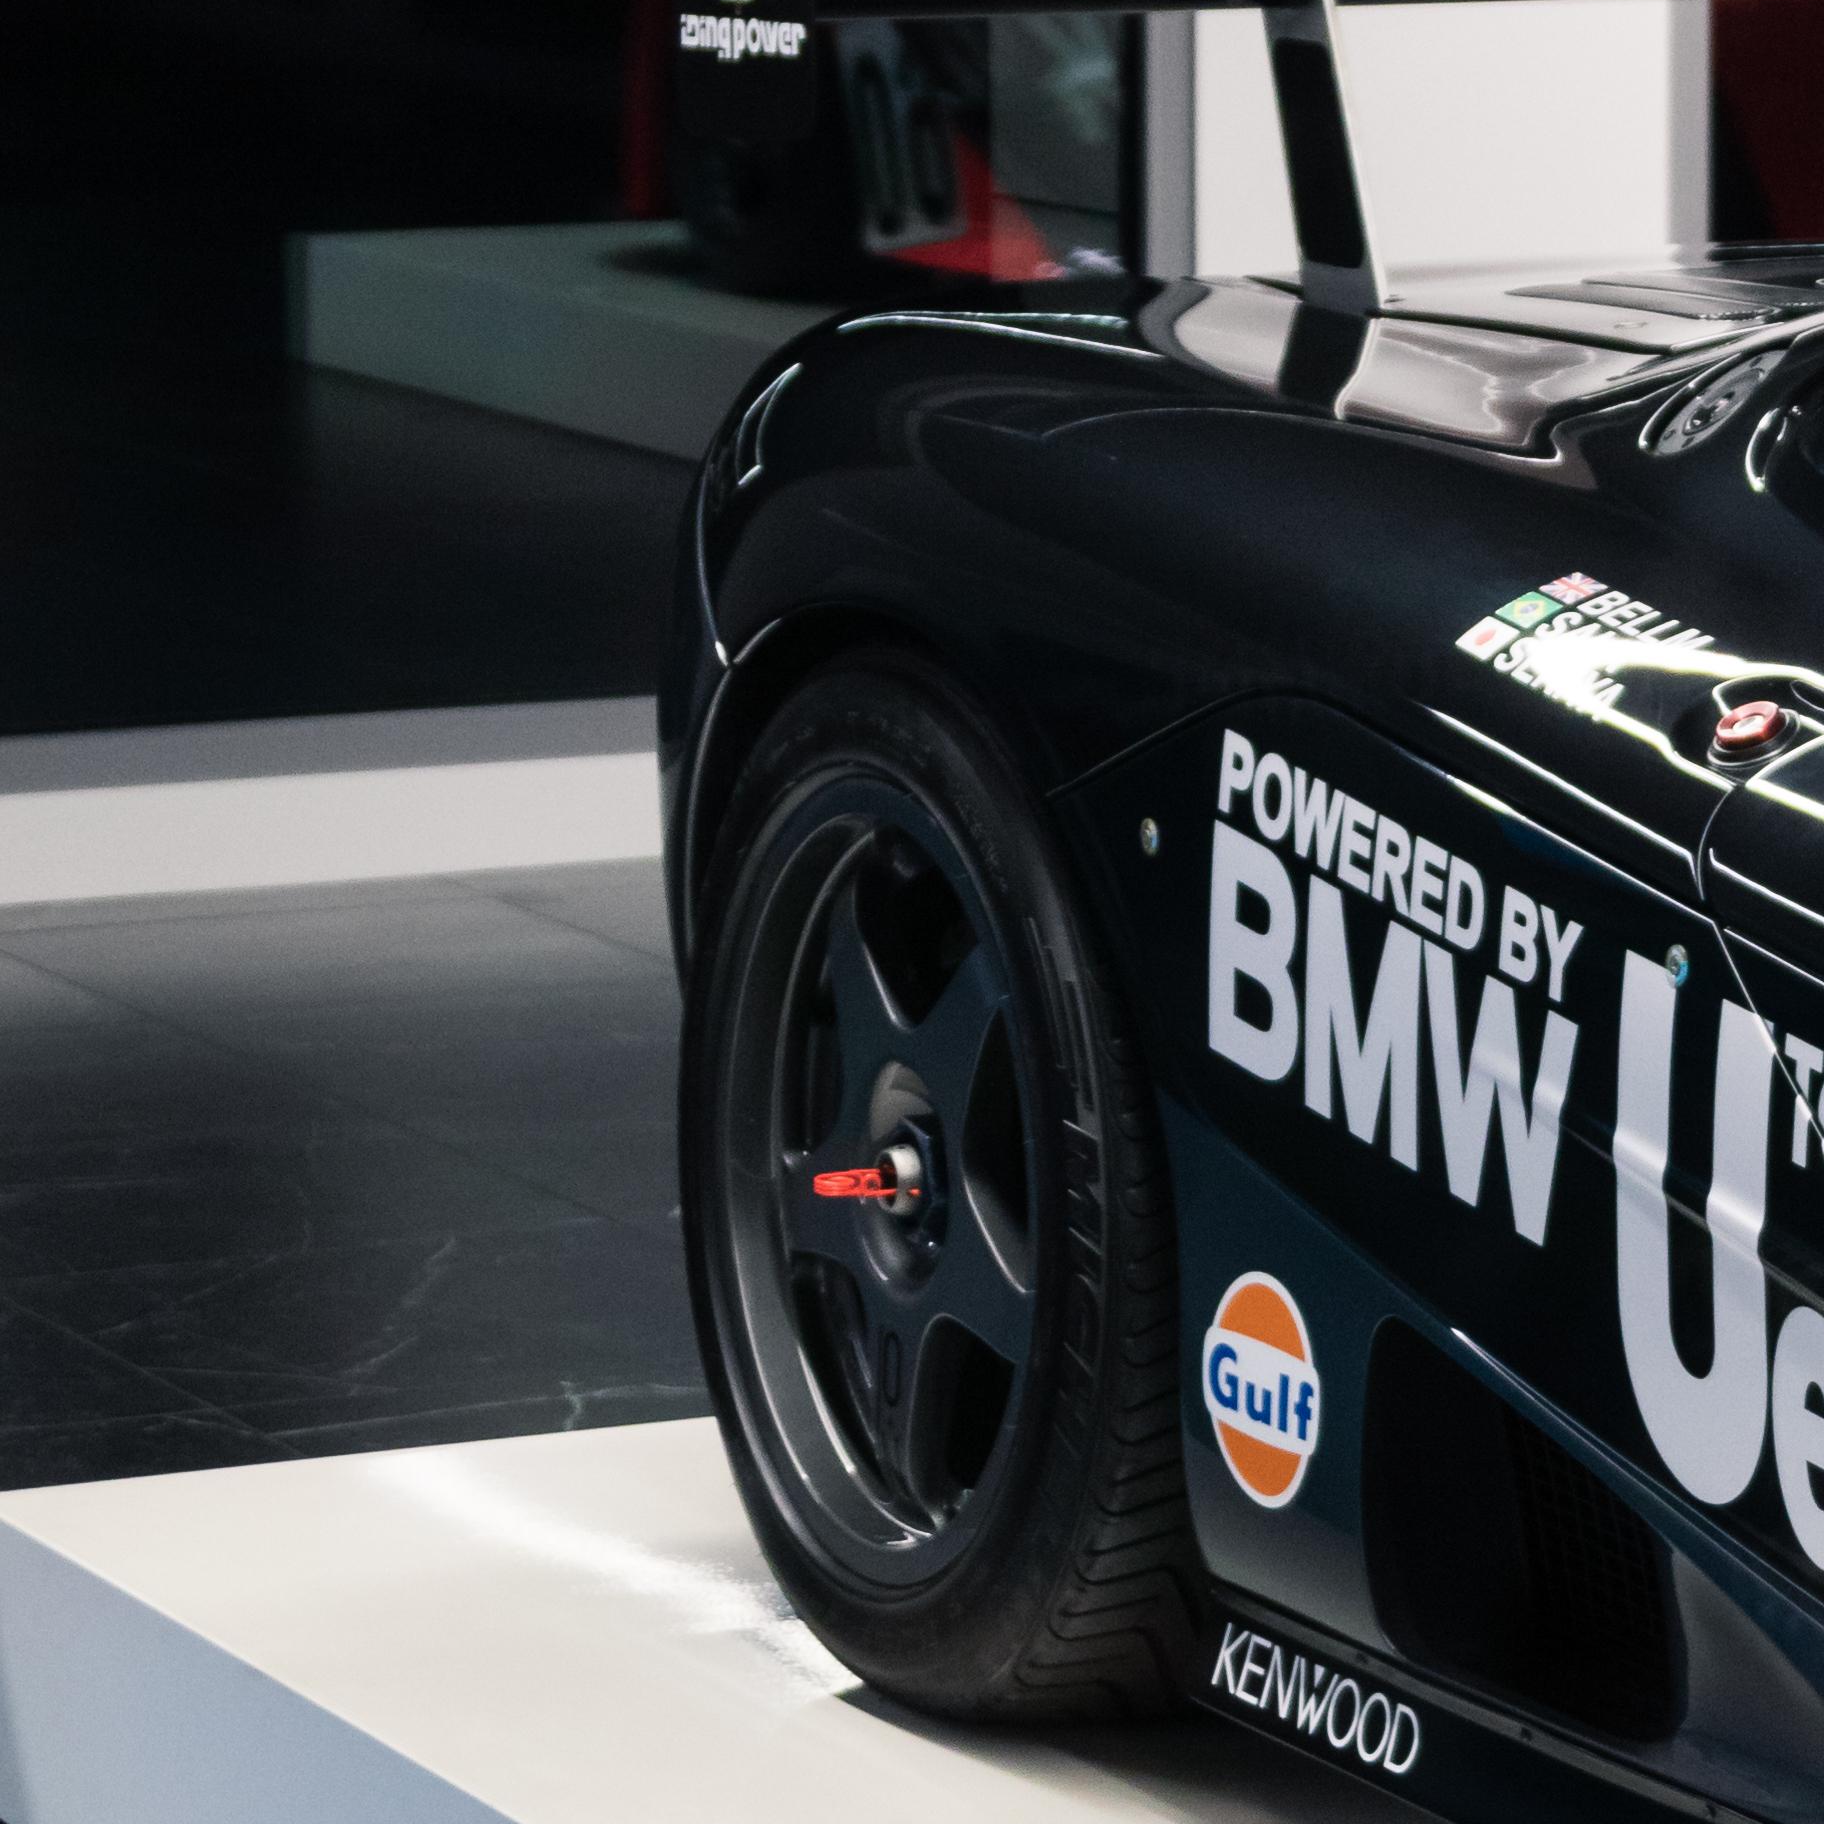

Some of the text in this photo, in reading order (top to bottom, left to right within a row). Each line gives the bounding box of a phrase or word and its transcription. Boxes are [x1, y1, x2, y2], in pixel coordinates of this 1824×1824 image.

[1217, 728, 1484, 953] POWERED
[1499, 885, 1584, 1001] BY
[1208, 819, 1580, 1247] BMW
[1209, 1341, 1314, 1441] Gulf
[1210, 1623, 1420, 1775] KENWOOD
